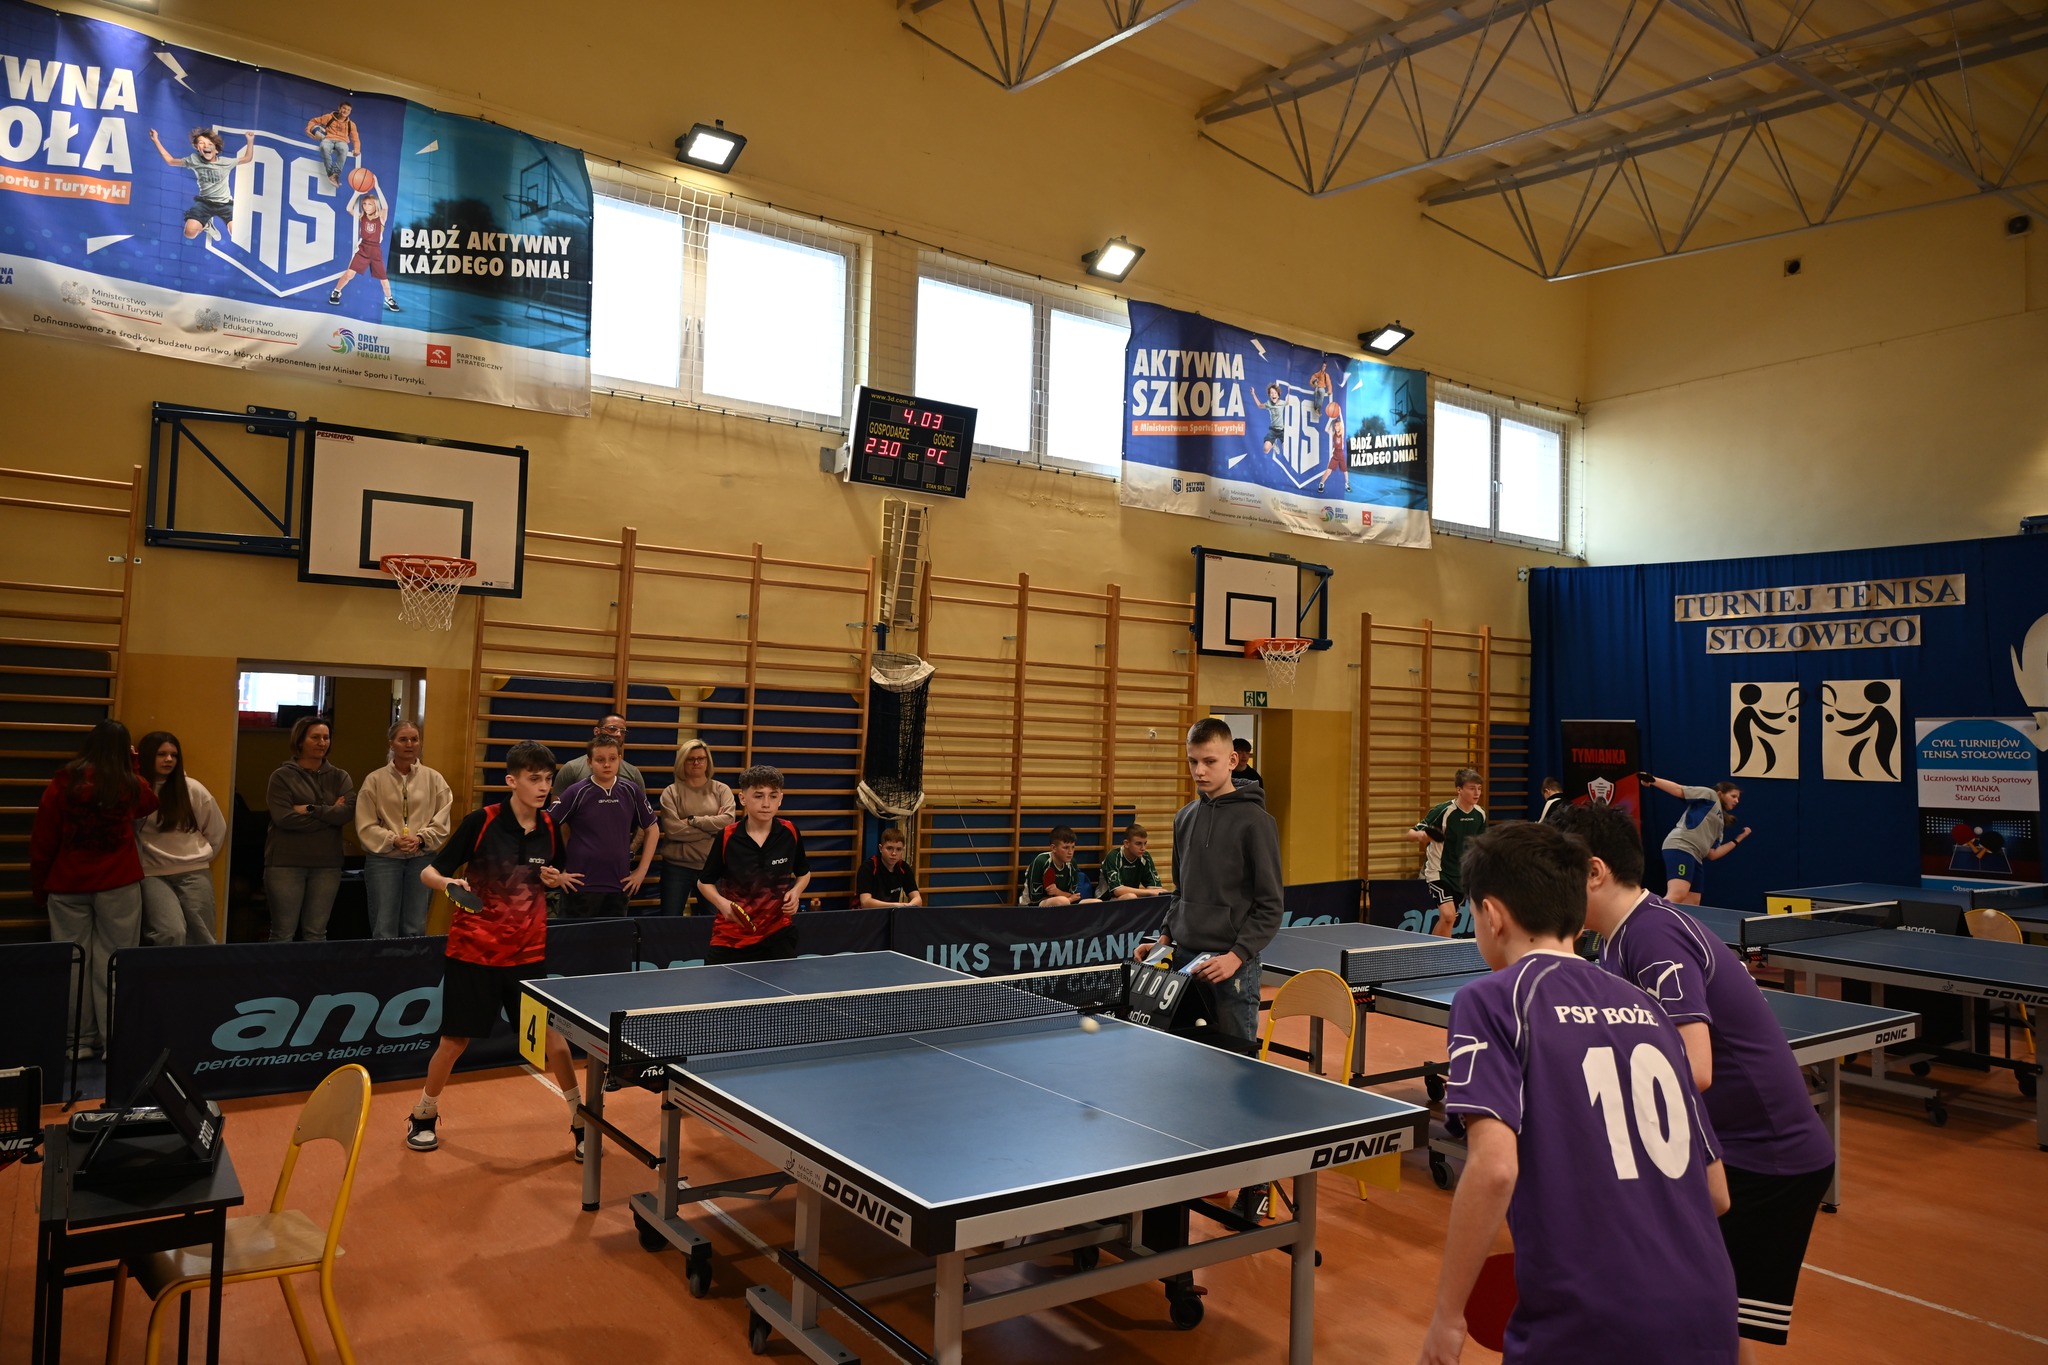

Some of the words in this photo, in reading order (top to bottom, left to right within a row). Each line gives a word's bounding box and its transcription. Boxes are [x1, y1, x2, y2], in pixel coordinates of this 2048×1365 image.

[44, 177, 49, 190] i
[54, 178, 126, 199] Turystyki
[400, 224, 460, 254] BĄDŹ
[467, 231, 571, 255] AKTYWNY
[399, 249, 504, 277] KAŻDEGO
[511, 258, 570, 280] DNIA!
[91, 288, 147, 307] Ministerstwo
[91, 296, 119, 310] Sportu
[126, 304, 164, 319] Turystyki
[223, 313, 274, 328] Ministerstwo
[222, 322, 255, 334] Edukacji
[256, 327, 299, 339] Narodowej
[357, 333, 378, 345] ORŁY
[33, 313, 104, 334] Dofinansowano
[106, 328, 117, 336] ze
[119, 329, 156, 345] środków
[157, 336, 192, 351] budżetu
[194, 345, 232, 358] państwa,
[233, 349, 264, 362] których
[265, 354, 317, 370] dysponentem
[318, 362, 331, 372] jest
[333, 366, 362, 377] Minister
[364, 370, 389, 381] Sportu
[394, 374, 426, 387] Turystyki.
[356, 351, 391, 362] FUNDACJA
[357, 342, 390, 355] SPORTU
[456, 352, 486, 362] PARTNER
[429, 358, 448, 366] ORLEN
[456, 358, 503, 371] STRATEGICZNY
[1133, 348, 1245, 380] AKTYWNA
[1132, 379, 1245, 417] SZKOŁA
[869, 421, 910, 441] GOSPODARZE
[1214, 424, 1244, 434] Turystyki
[865, 437, 901, 458] 23.0
[933, 433, 956, 448] GOŚCIE
[1350, 433, 1372, 453] BĄDŹ
[1375, 433, 1418, 449] AKTYWNY
[907, 452, 920, 462] SET
[1350, 450, 1391, 467] KAŻDEGO
[1393, 448, 1418, 464] DNIA!
[1677, 586, 1814, 619] TURNIEJ
[1827, 577, 1962, 610] TENISA
[1708, 617, 1918, 651] STOŁOWEGO
[1931, 739, 1957, 748] CYKL
[1959, 737, 2020, 749] TURNIEJÓW
[1571, 747, 1627, 765] TYMIANKA
[1922, 750, 1959, 759] TENISA
[1961, 750, 2031, 760] STOŁOWEGO
[1923, 774, 1969, 783] Uczniowski
[1971, 775, 1990, 783] Klub
[1992, 776, 2032, 785] Sportowy
[1955, 784, 2000, 792] TYMIANKA
[1955, 793, 1976, 803] Stary
[1977, 794, 2001, 802] Gózd
[1678, 863, 1686, 876] 9
[926, 942, 991, 973] UKS
[1554, 1005, 1598, 1024] PSP
[527, 1014, 536, 1052] 4
[1875, 1027, 1908, 1045] DONIC
[193, 1050, 323, 1075] performance
[327, 1044, 373, 1060] table
[375, 1038, 432, 1056] tennis
[1581, 1042, 1691, 1180] 10
[1310, 1131, 1402, 1170] DONIC
[798, 1163, 813, 1177] MADE
[796, 1171, 822, 1190] GERMANY
[822, 1173, 904, 1237] DONIC
